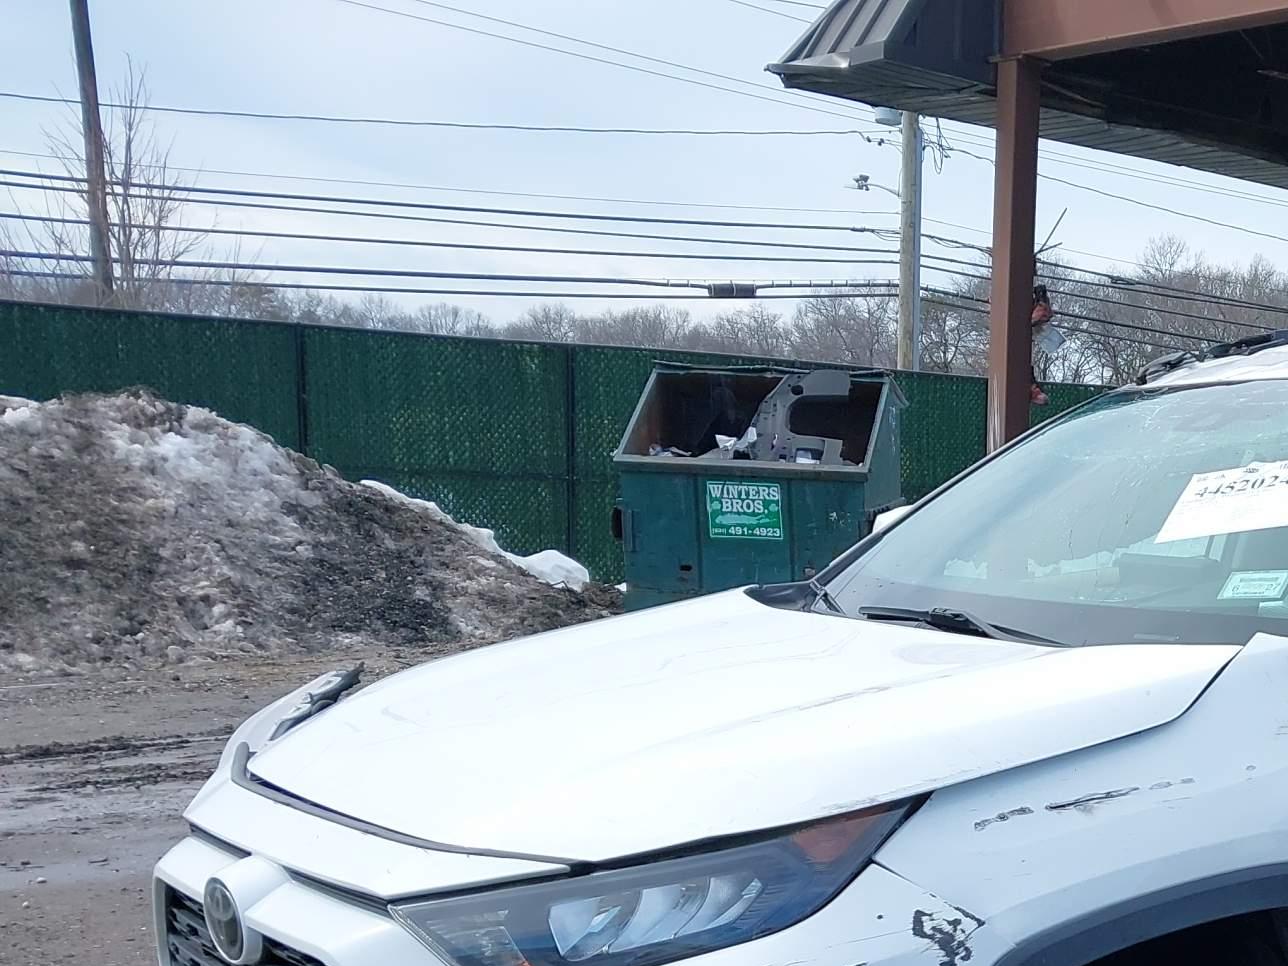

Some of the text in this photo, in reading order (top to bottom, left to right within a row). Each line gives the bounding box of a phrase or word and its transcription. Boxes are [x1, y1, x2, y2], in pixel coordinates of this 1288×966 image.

[709, 484, 779, 501] WINTERS
[721, 499, 768, 514] BROS.
[728, 526, 780, 537] 491-4923
